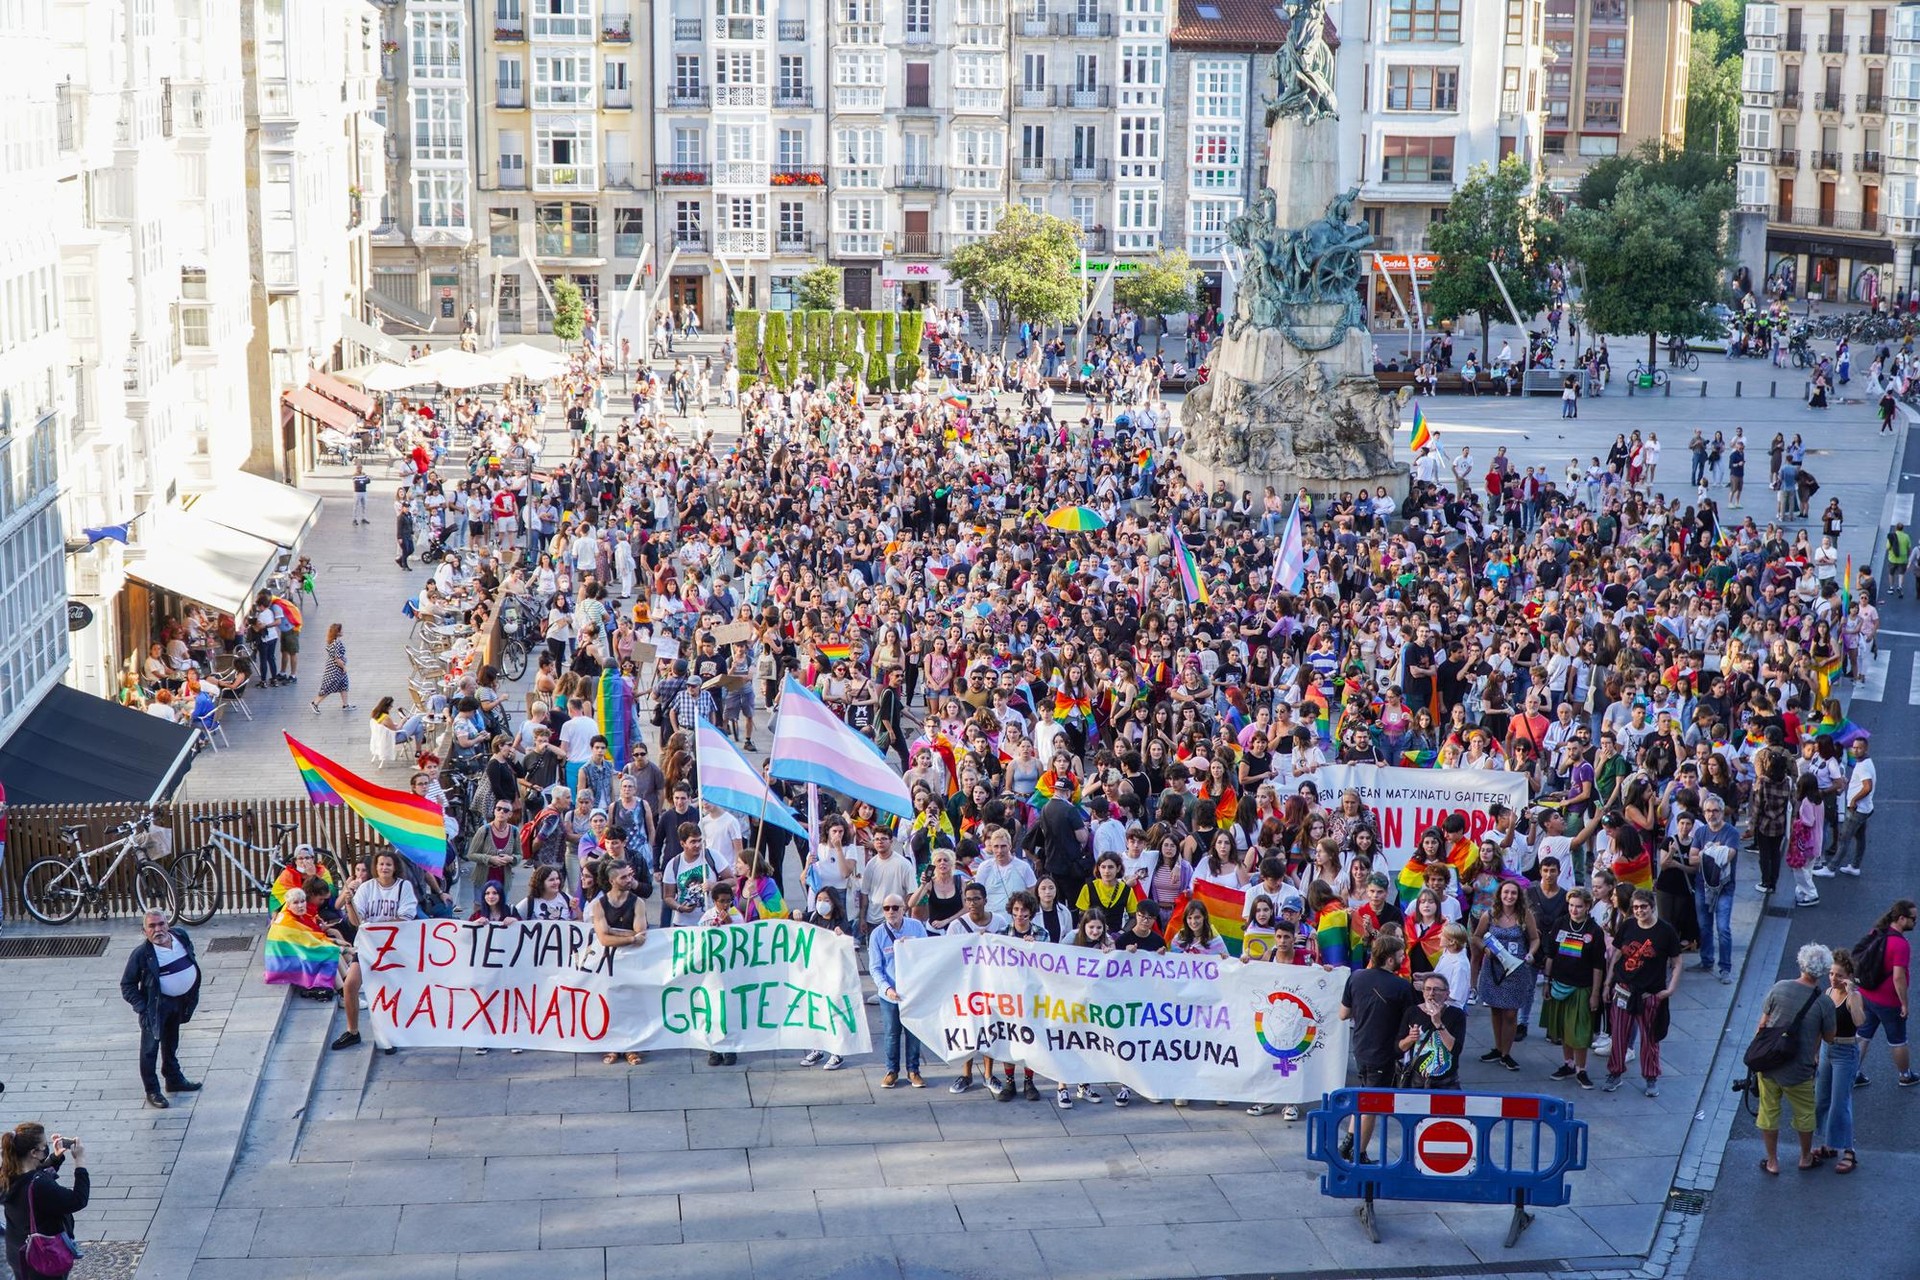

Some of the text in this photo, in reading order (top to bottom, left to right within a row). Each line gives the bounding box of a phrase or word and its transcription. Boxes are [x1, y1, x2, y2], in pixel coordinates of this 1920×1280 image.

[1386, 788, 1451, 801] MATXINATU
[1455, 791, 1511, 804] GAITEZEN
[671, 921, 816, 977] AURREAN
[961, 945, 1220, 981] FAXISMOA EZ DA PASAKO
[661, 980, 858, 1036] GAITEZEN
[953, 992, 1232, 1031] LGTBI HARROTASUNA
[944, 1020, 1240, 1069] KLASEKO HARROTASUNA
